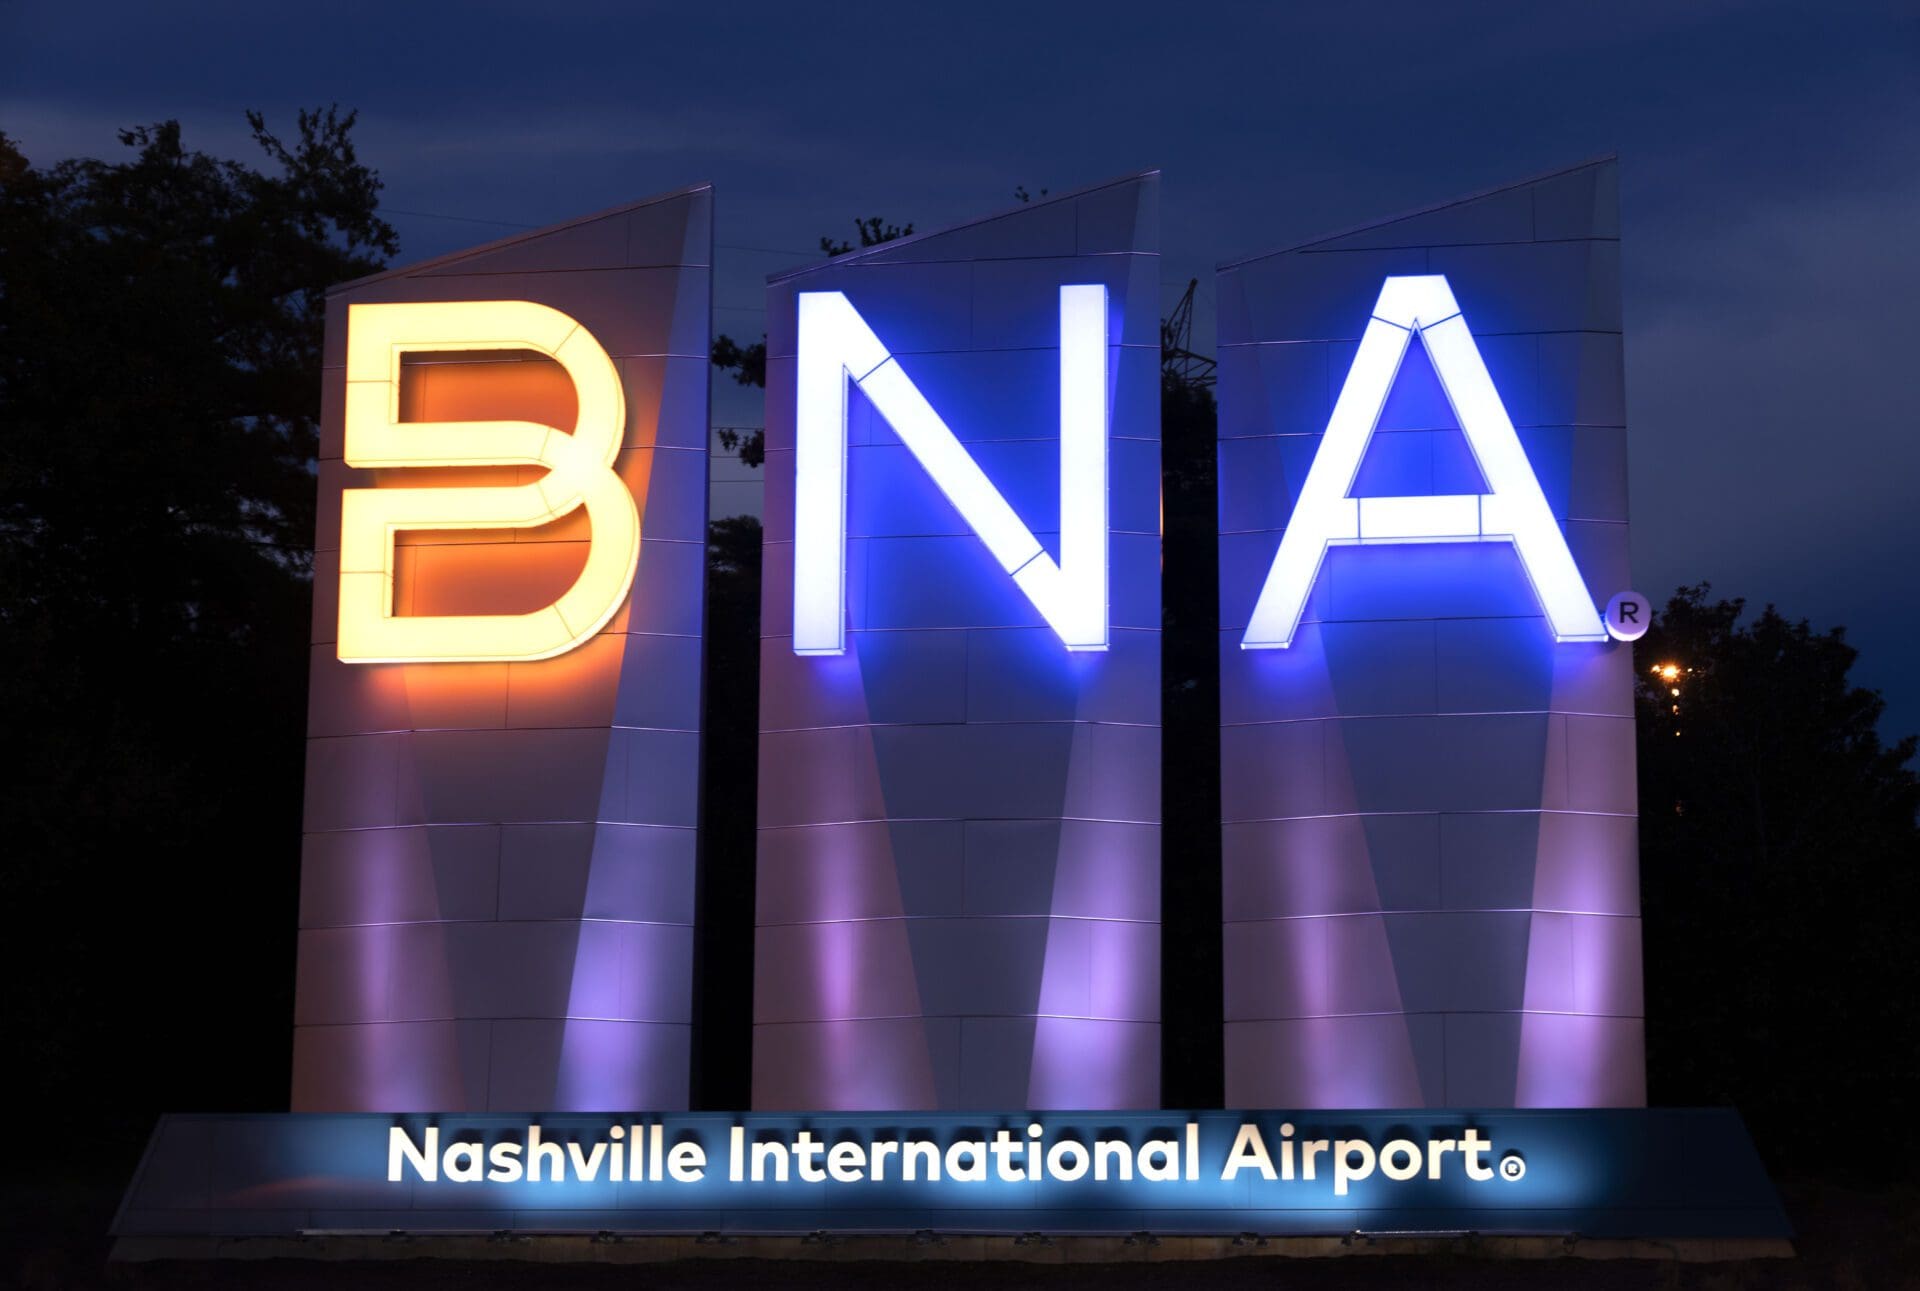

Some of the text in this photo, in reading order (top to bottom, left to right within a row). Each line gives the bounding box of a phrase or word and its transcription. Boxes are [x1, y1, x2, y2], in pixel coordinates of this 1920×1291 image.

[337, 274, 1608, 663] BNA
[387, 1125, 706, 1182] Nashville
[729, 1123, 1199, 1182] International
[1220, 1123, 1494, 1195] Airport
